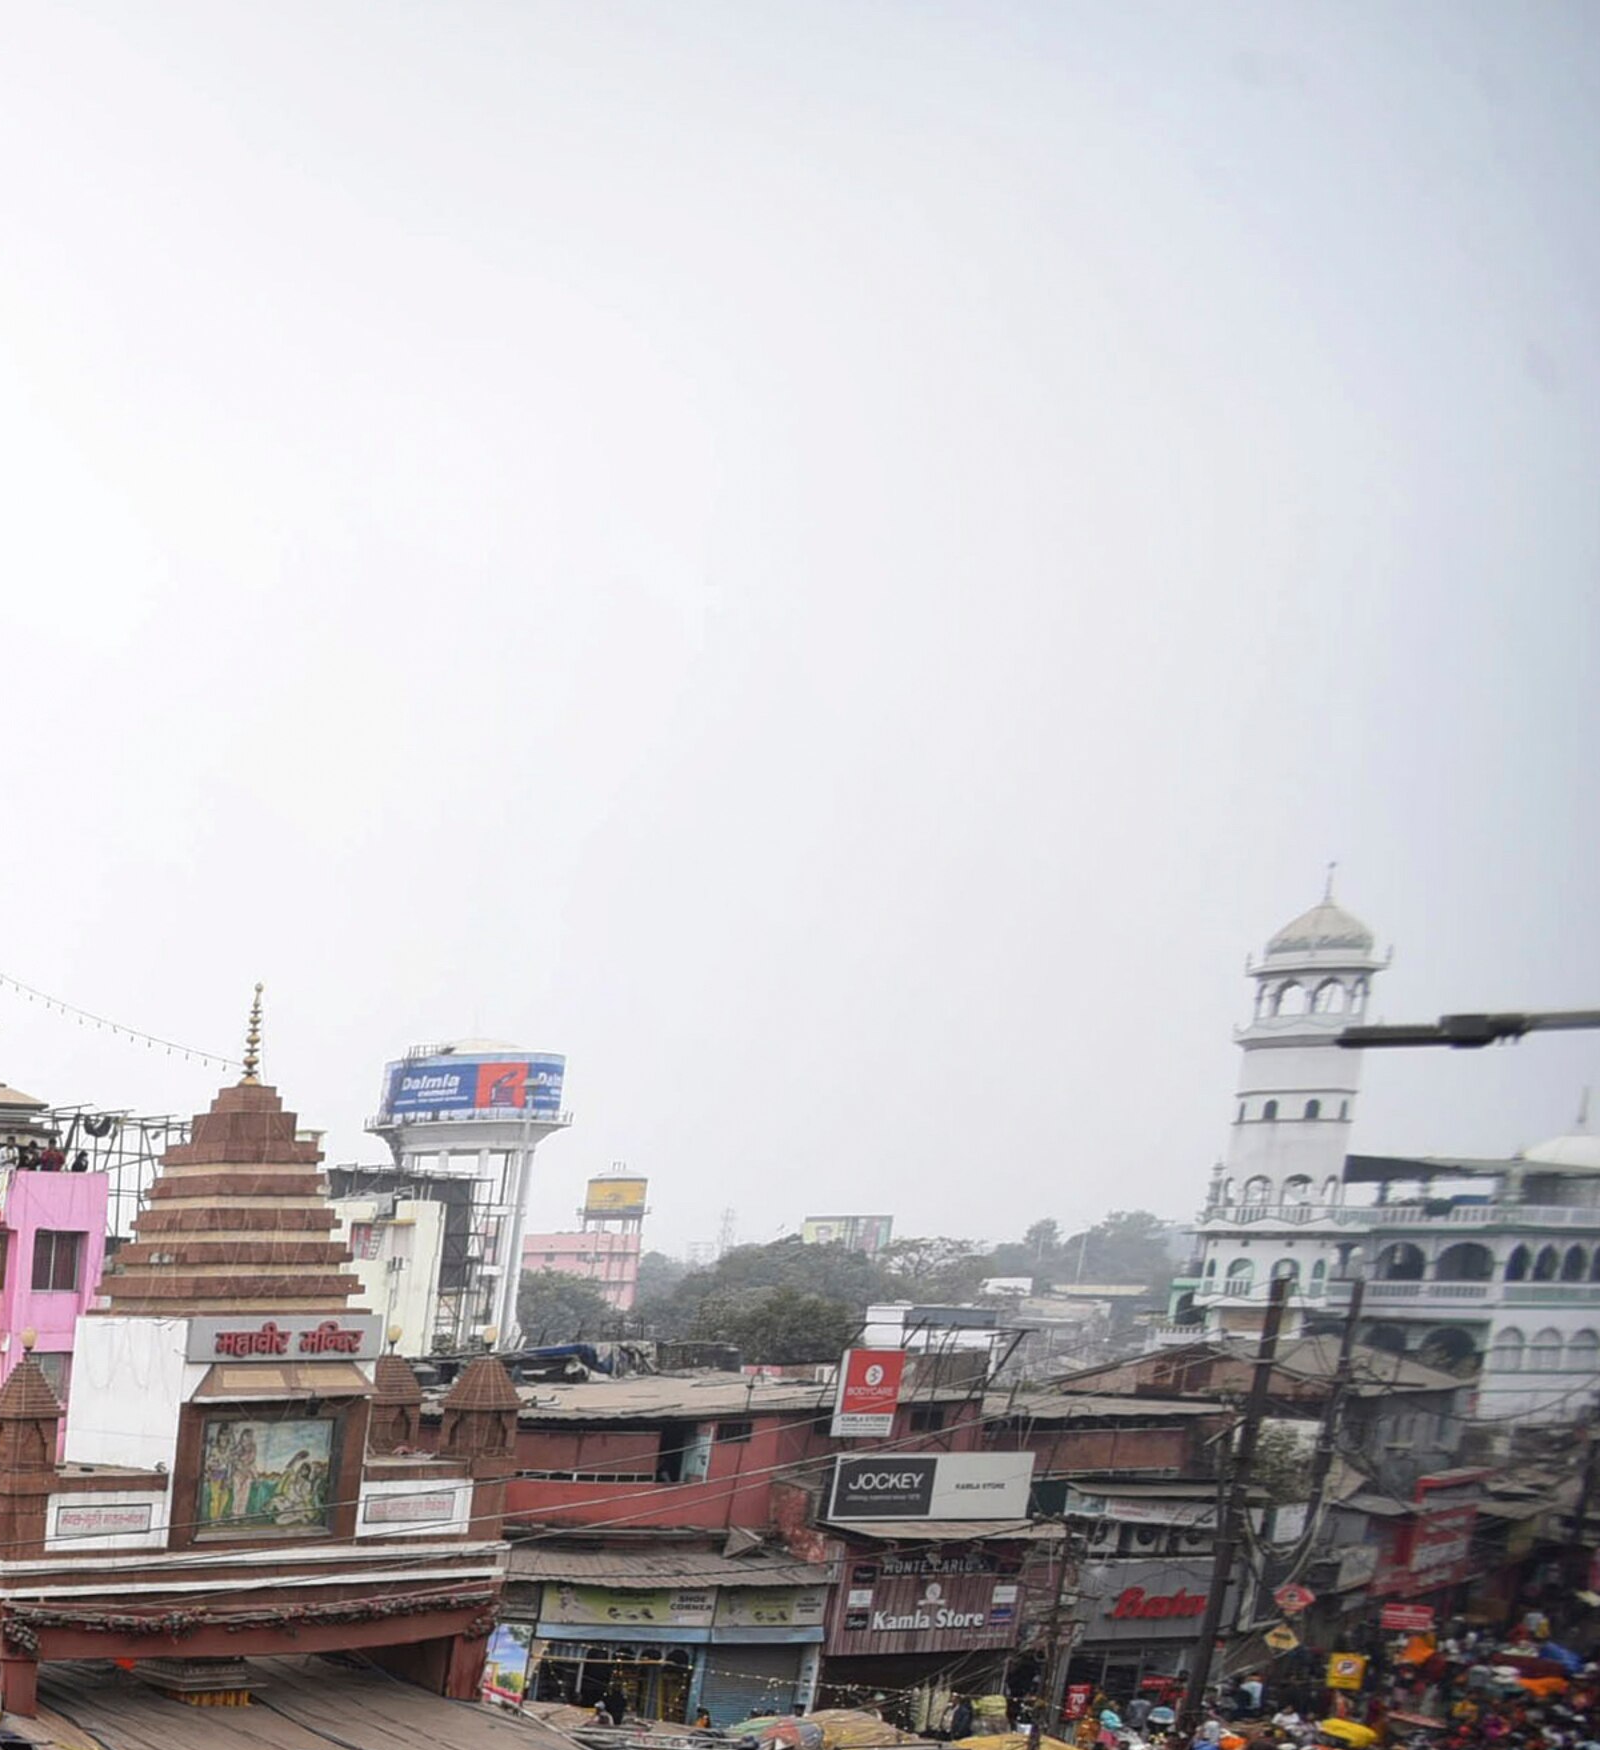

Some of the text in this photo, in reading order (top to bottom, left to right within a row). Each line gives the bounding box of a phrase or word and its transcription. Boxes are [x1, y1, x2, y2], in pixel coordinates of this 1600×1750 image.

[402, 1073, 461, 1091] Dalmia
[214, 1320, 365, 1358] महावीर मन्दिर
[846, 1386, 894, 1397] BODYCARE
[848, 1472, 925, 1491] JOCKEY
[883, 1558, 928, 1574] MONTE
[872, 1610, 931, 1631] Kamla
[934, 1608, 985, 1630] Store
